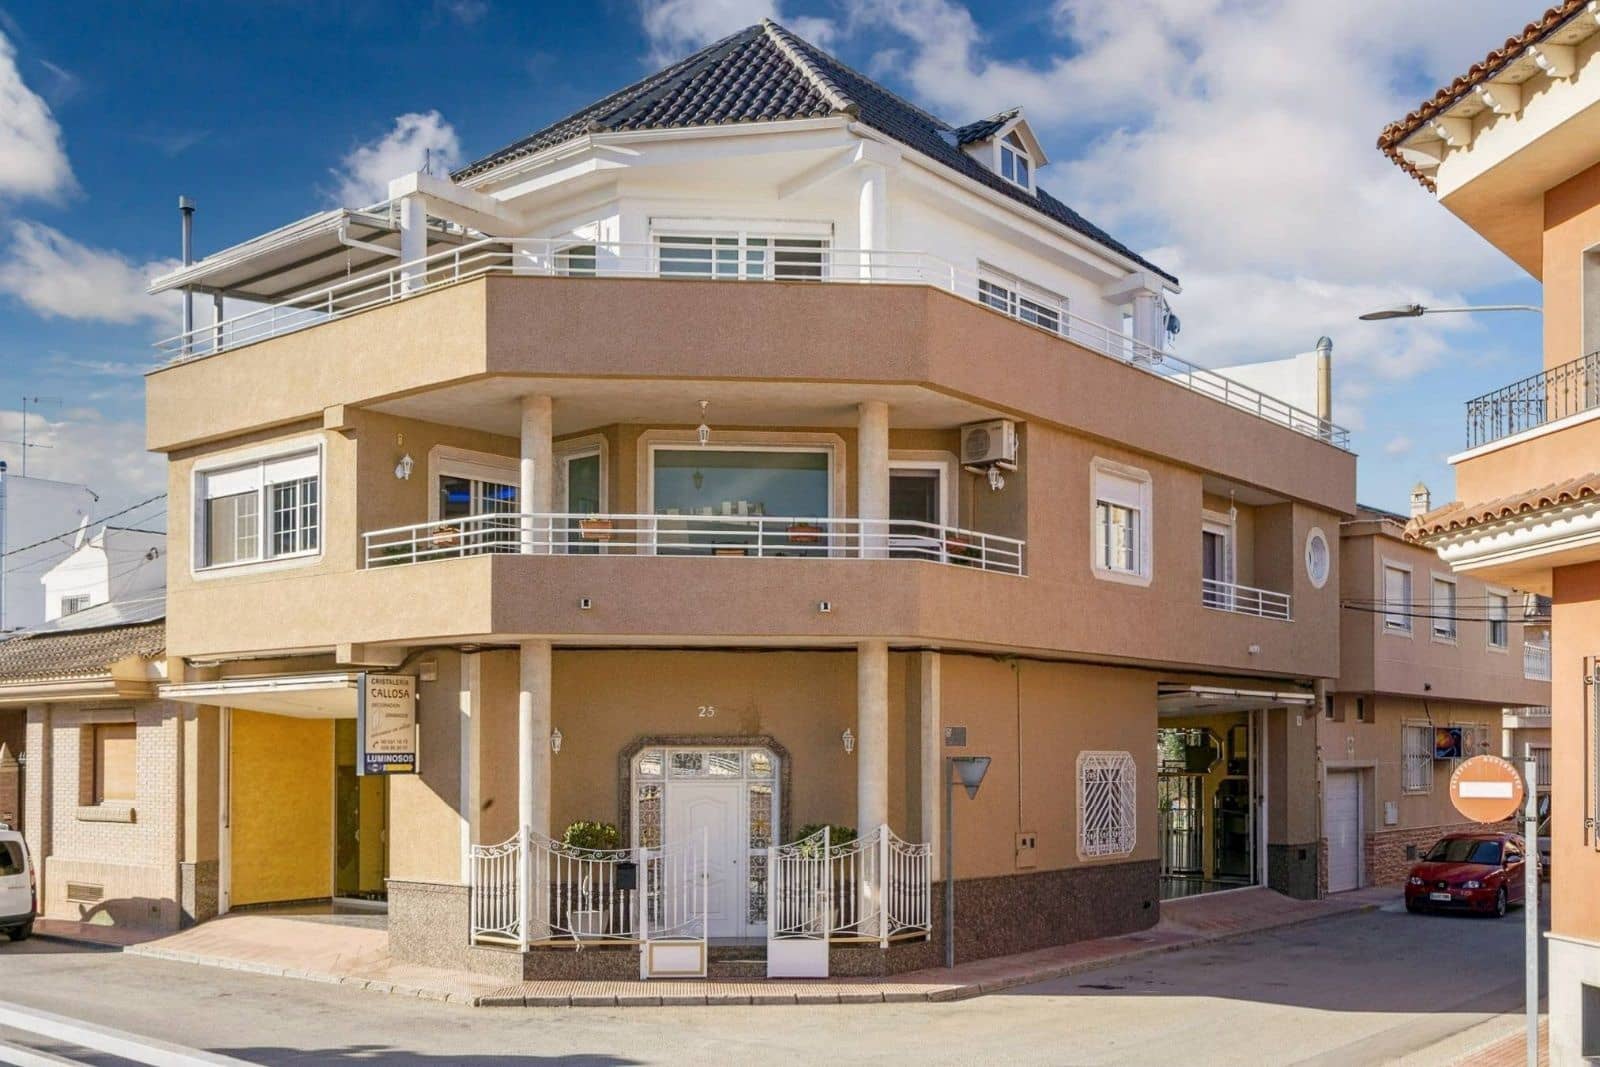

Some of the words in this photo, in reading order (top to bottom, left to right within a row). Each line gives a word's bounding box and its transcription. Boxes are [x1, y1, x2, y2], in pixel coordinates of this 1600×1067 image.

[371, 688, 410, 699] CALLOSA
[697, 706, 715, 718] 25
[366, 754, 414, 763] LUMINOSOS
